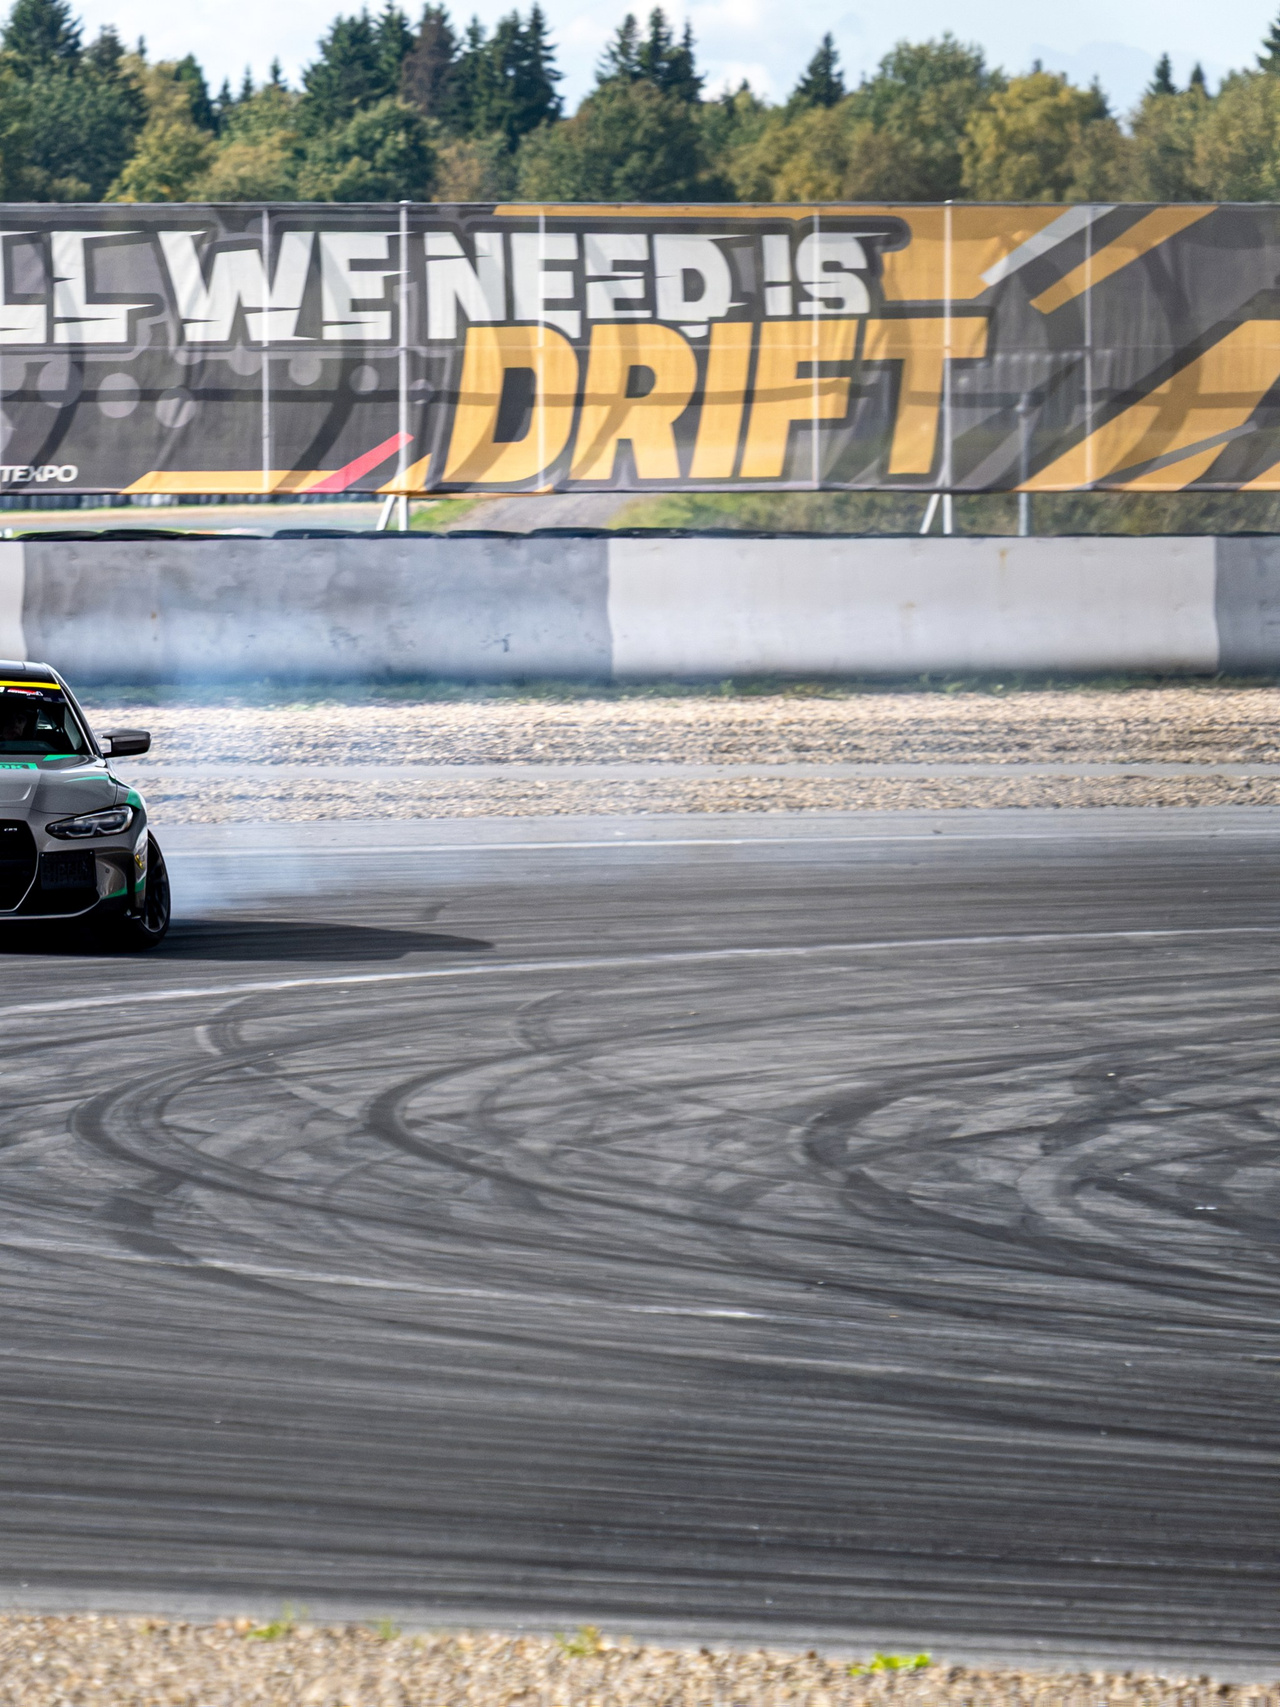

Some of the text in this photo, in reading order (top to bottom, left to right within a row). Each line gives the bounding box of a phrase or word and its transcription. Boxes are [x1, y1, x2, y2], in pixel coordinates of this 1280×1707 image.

[158, 230, 410, 342] WE
[424, 231, 748, 340] NEED
[761, 232, 891, 316] IS
[442, 316, 988, 483] DRIFT
